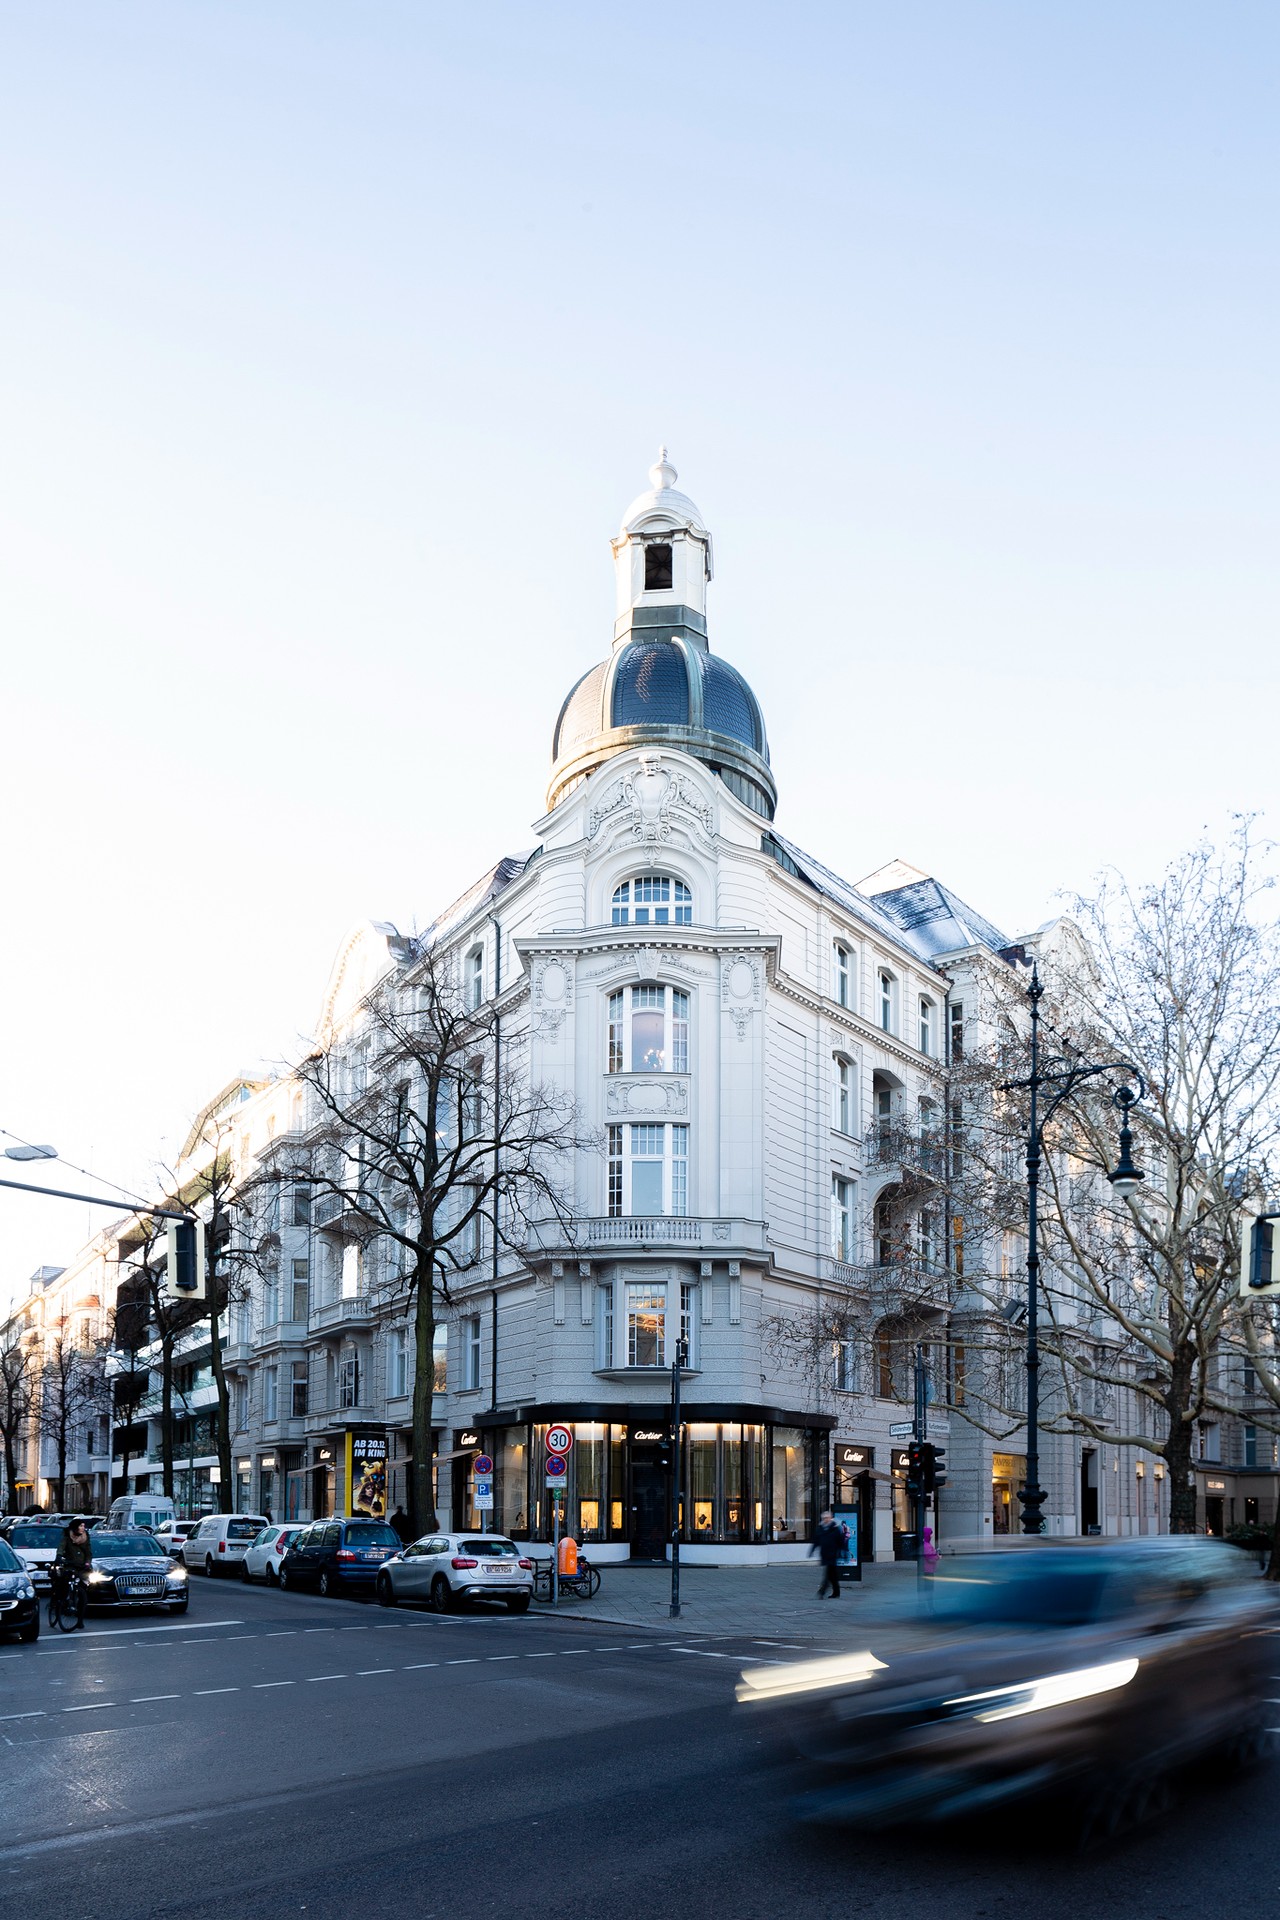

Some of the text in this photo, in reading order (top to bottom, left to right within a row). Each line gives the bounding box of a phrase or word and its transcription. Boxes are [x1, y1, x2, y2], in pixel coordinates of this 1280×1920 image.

[461, 1433, 478, 1445] Cartier
[551, 1433, 567, 1447] 30
[634, 1430, 663, 1440] Cartier
[354, 1440, 366, 1449] AB
[354, 1449, 386, 1458] IM KINO
[844, 1449, 864, 1462] Cartier
[479, 1485, 486, 1494] P
